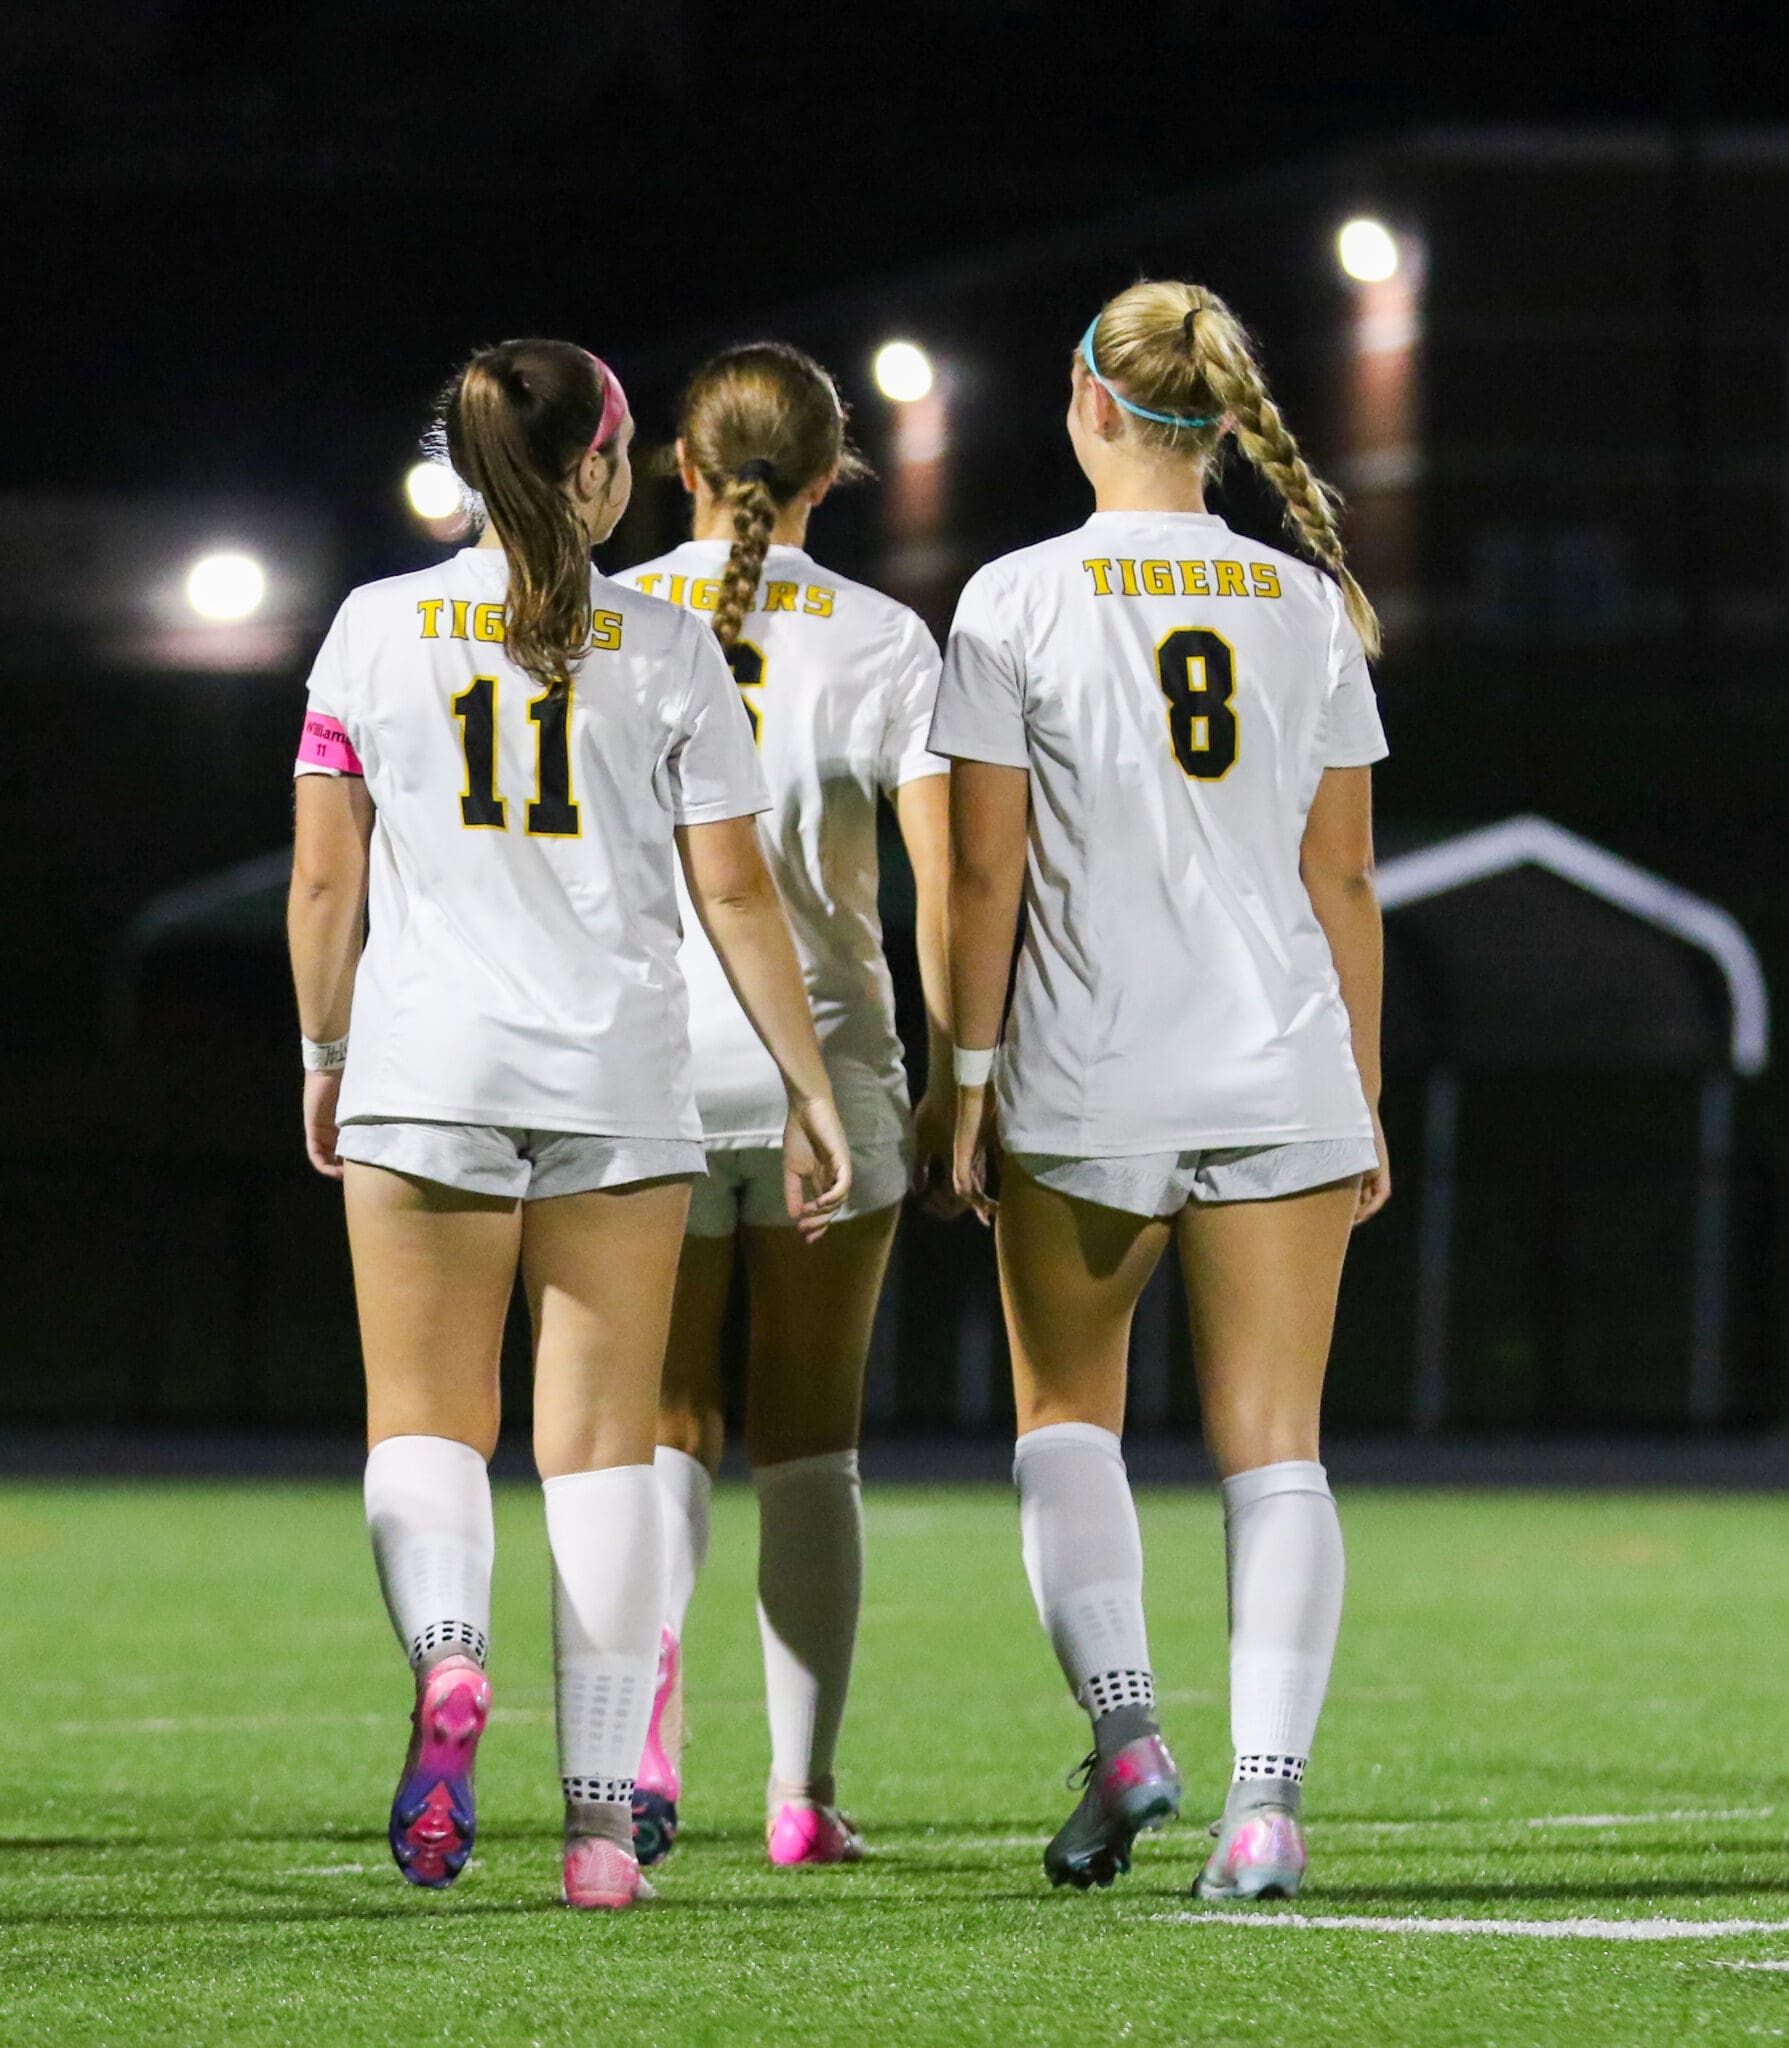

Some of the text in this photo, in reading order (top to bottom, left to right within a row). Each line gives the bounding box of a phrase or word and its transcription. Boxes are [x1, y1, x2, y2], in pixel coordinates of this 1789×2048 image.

[635, 573, 836, 618] TIGRS
[1082, 558, 1282, 598] TIGERS
[417, 598, 623, 651] TIGS
[1154, 625, 1240, 783] 8
[316, 743, 327, 758] 11
[451, 674, 582, 838] 11
